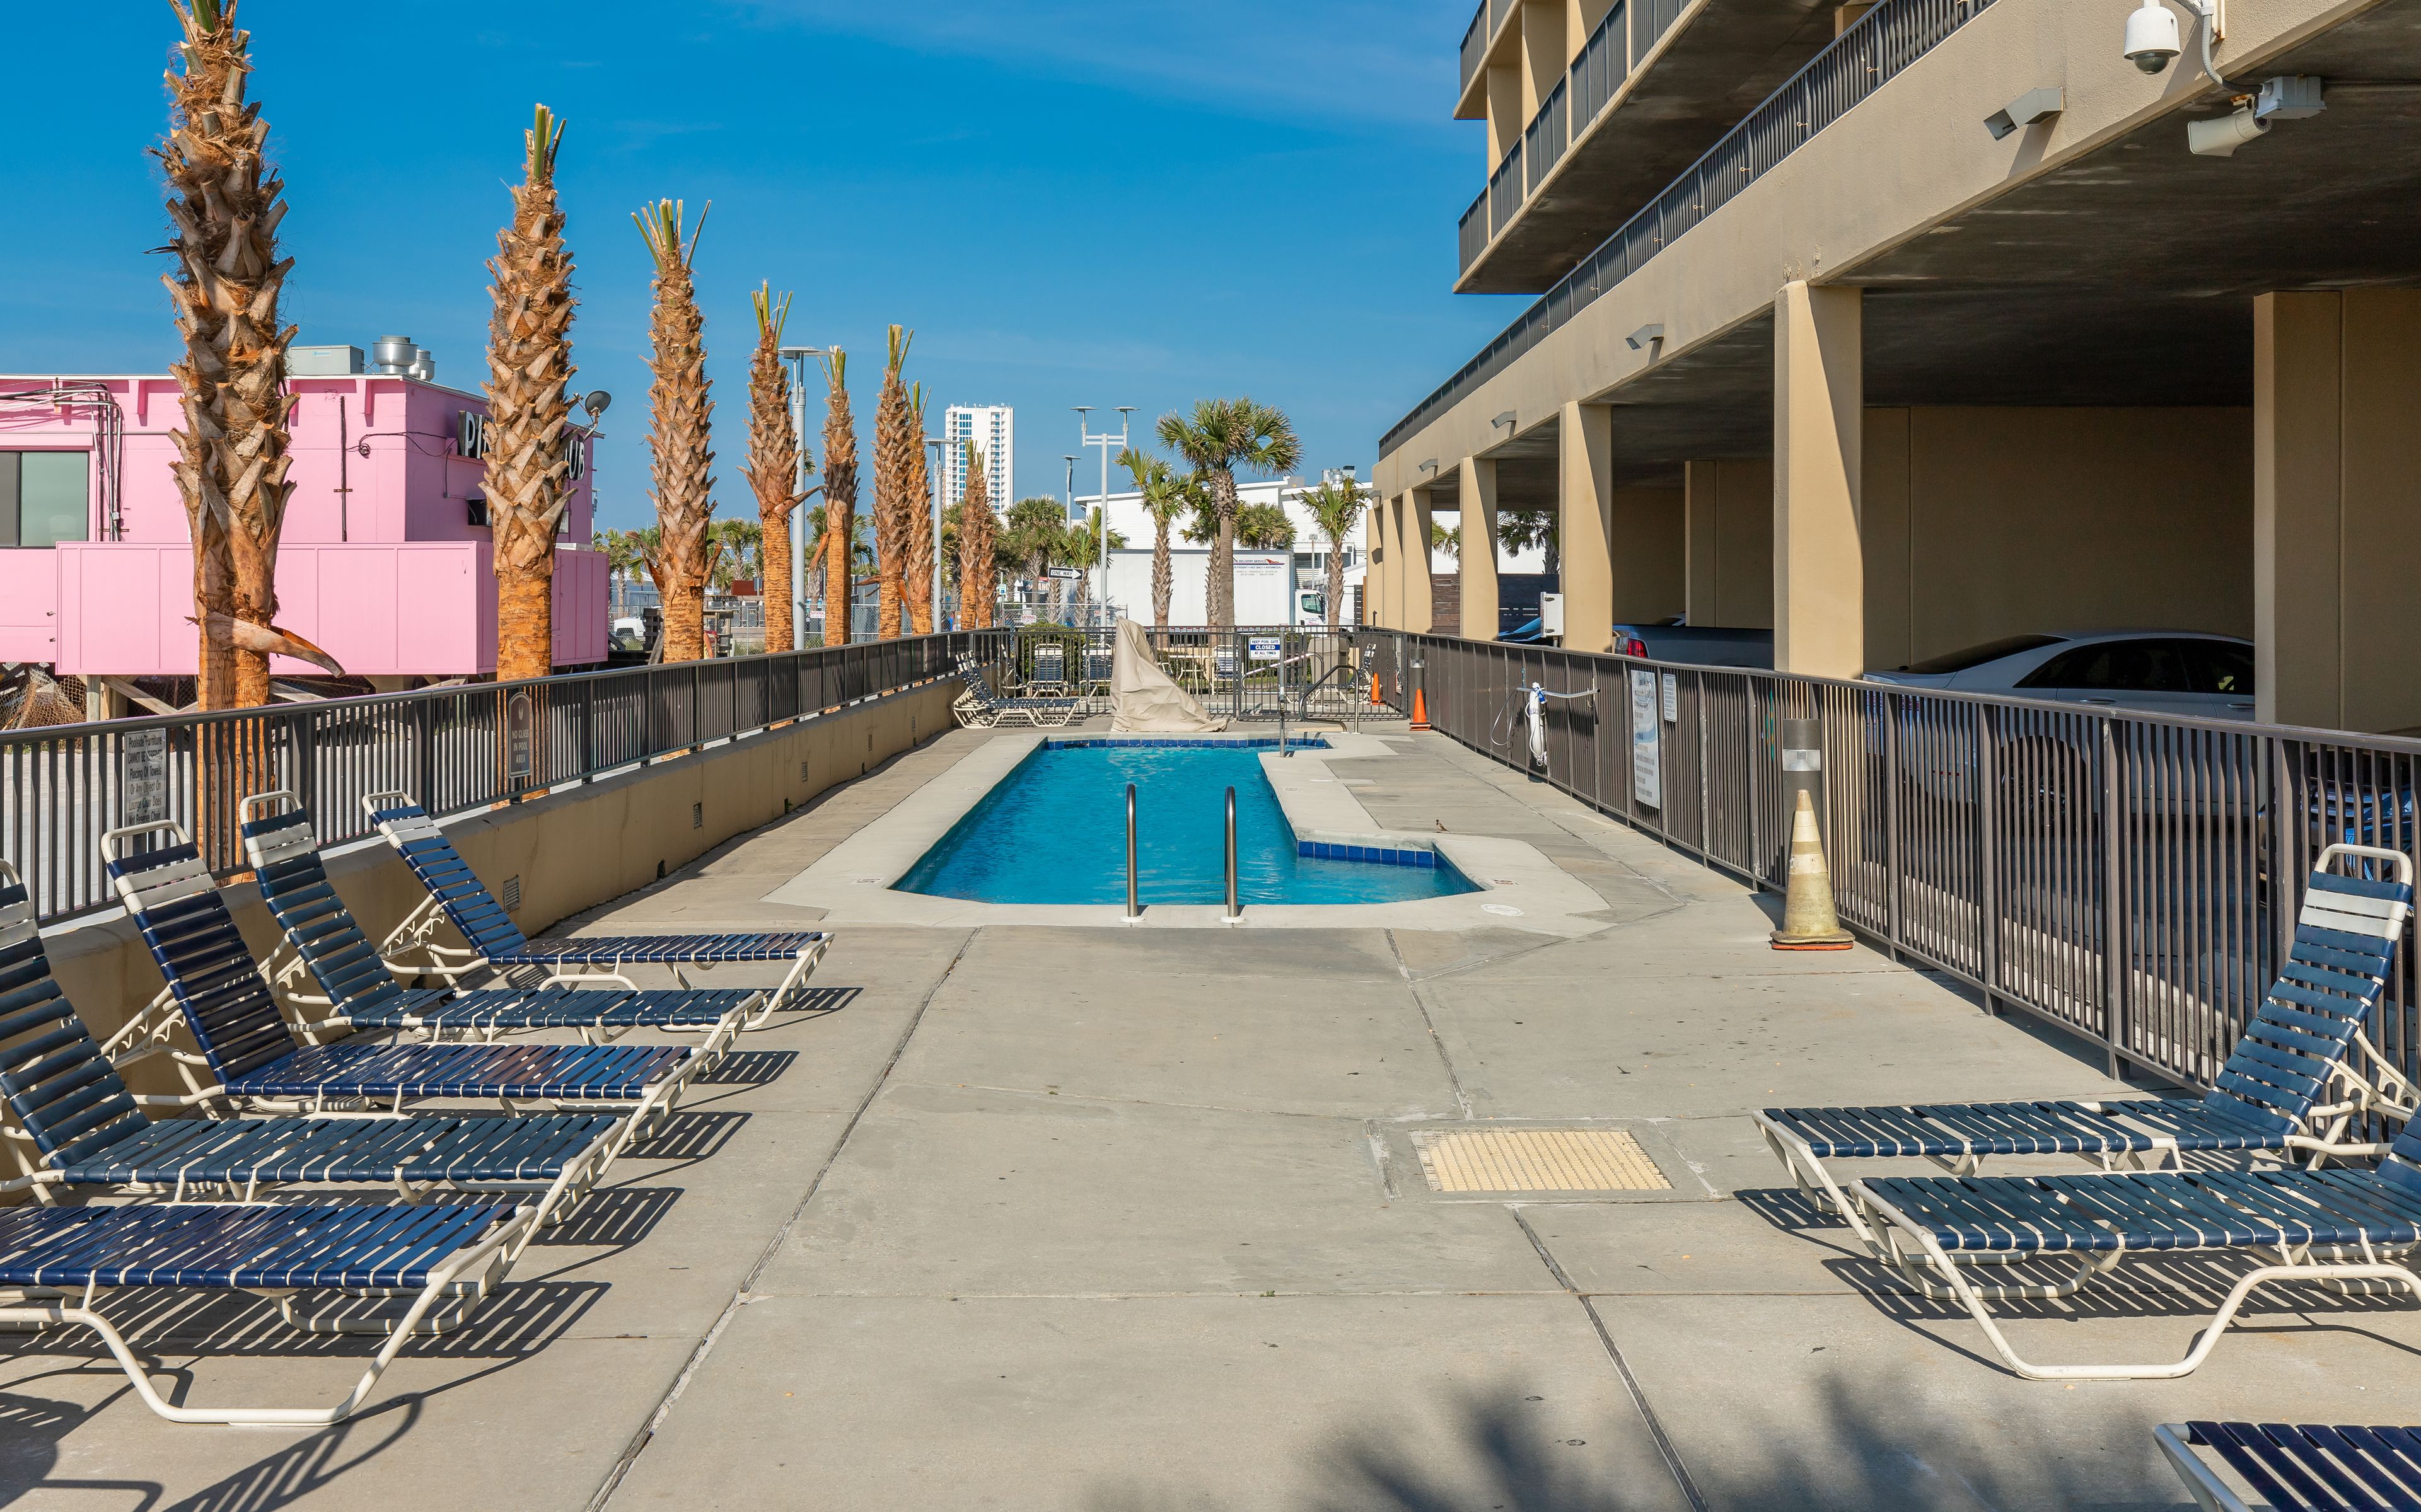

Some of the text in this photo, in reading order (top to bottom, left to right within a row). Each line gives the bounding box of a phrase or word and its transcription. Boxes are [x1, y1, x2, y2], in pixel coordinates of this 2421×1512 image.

[565, 439, 585, 480] UB
[512, 729, 529, 739] NO GLASS
[129, 735, 162, 748] Poolside Furniture
[513, 742, 527, 751] IN POOL
[128, 752, 140, 764] CANNOT
[141, 751, 145, 762] BE
[516, 754, 526, 764] AREA
[130, 765, 162, 780] Placing Of Towels
[131, 784, 135, 795] Or
[143, 782, 155, 795] Object
[156, 780, 161, 791] On
[129, 800, 141, 812] Lounge
[153, 796, 162, 806] Does
[136, 814, 150, 824] Reserve
